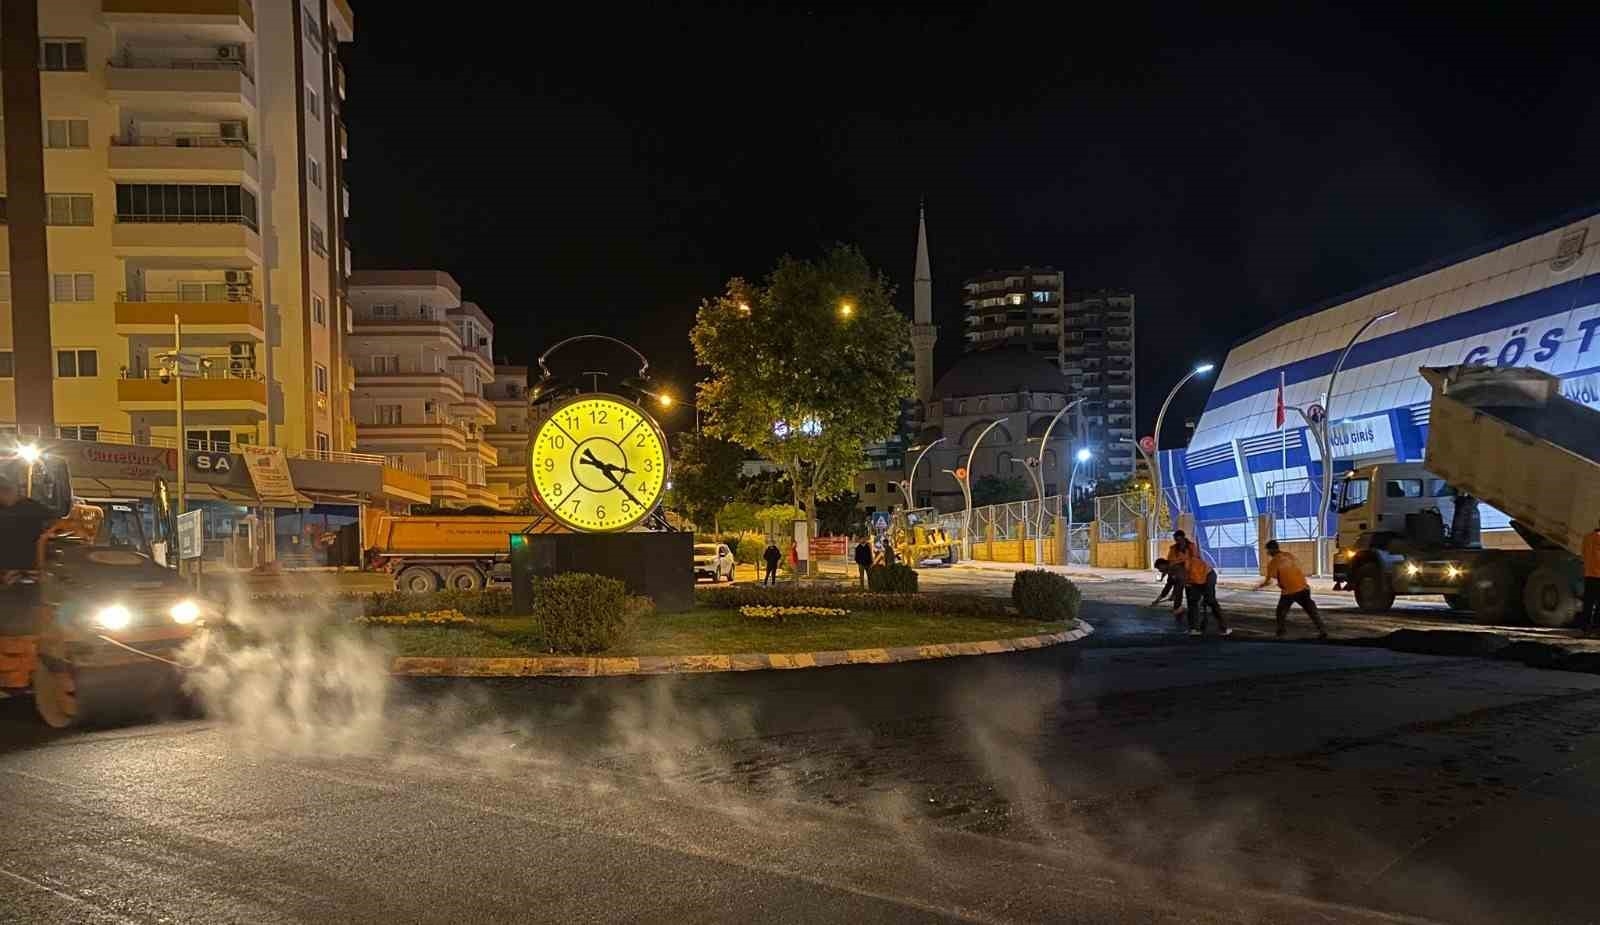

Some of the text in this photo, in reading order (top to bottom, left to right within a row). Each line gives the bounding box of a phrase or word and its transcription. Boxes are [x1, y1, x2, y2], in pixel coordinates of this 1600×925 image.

[566, 416, 580, 430] 11
[590, 410, 608, 425] 12
[618, 418, 625, 431] 1
[549, 434, 565, 449] 10
[637, 434, 646, 447] 2
[544, 458, 554, 472] 9
[643, 458, 653, 472] 3
[553, 483, 562, 497] 8
[638, 481, 647, 494] 4
[572, 500, 581, 514] 7
[596, 506, 606, 519] 6
[621, 501, 631, 513] 5
